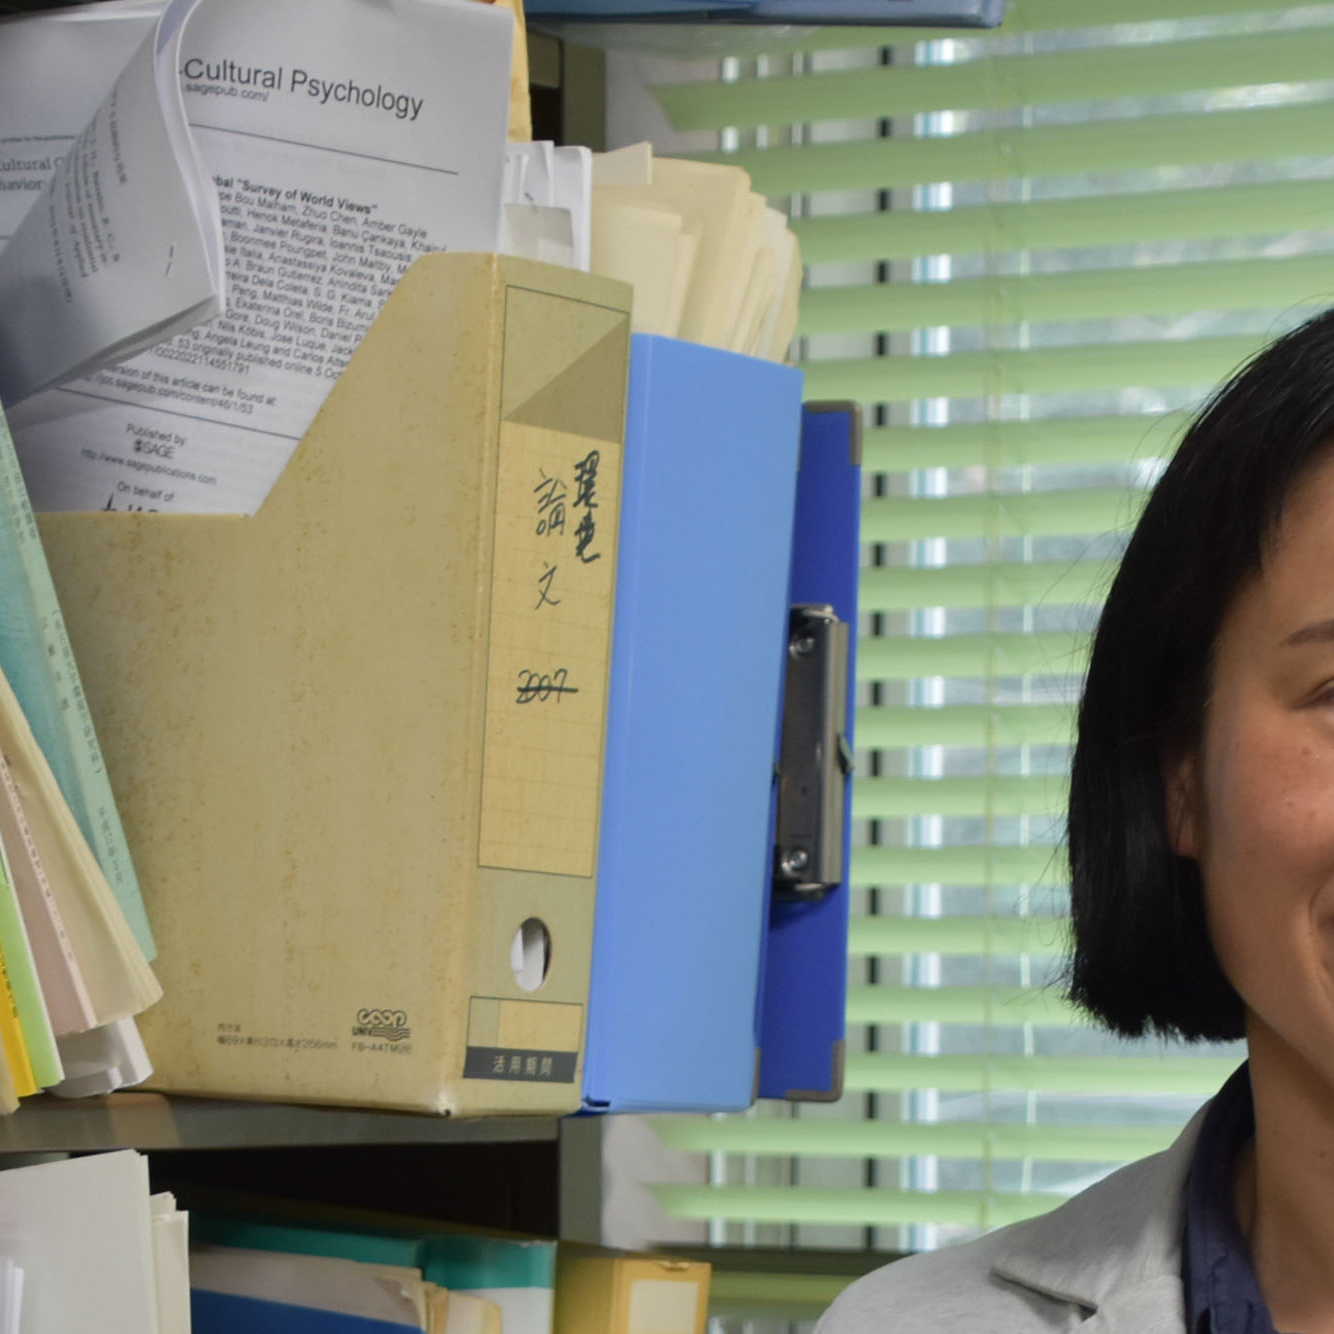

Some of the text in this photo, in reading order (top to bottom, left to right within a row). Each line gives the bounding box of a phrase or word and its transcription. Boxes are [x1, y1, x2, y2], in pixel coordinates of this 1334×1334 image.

[184, 59, 424, 121] Cultural Psychology
[285, 189, 298, 200] of
[301, 191, 335, 208] World
[337, 198, 379, 215] Views"
[363, 217, 396, 233] Amber
[398, 223, 428, 239] Gayle
[272, 346, 292, 358] and
[172, 376, 202, 391] article
[222, 385, 237, 398] be
[238, 390, 266, 405] found
[126, 423, 173, 443] Published
[143, 441, 175, 460] SAGE
[117, 480, 175, 503] On behalf of
